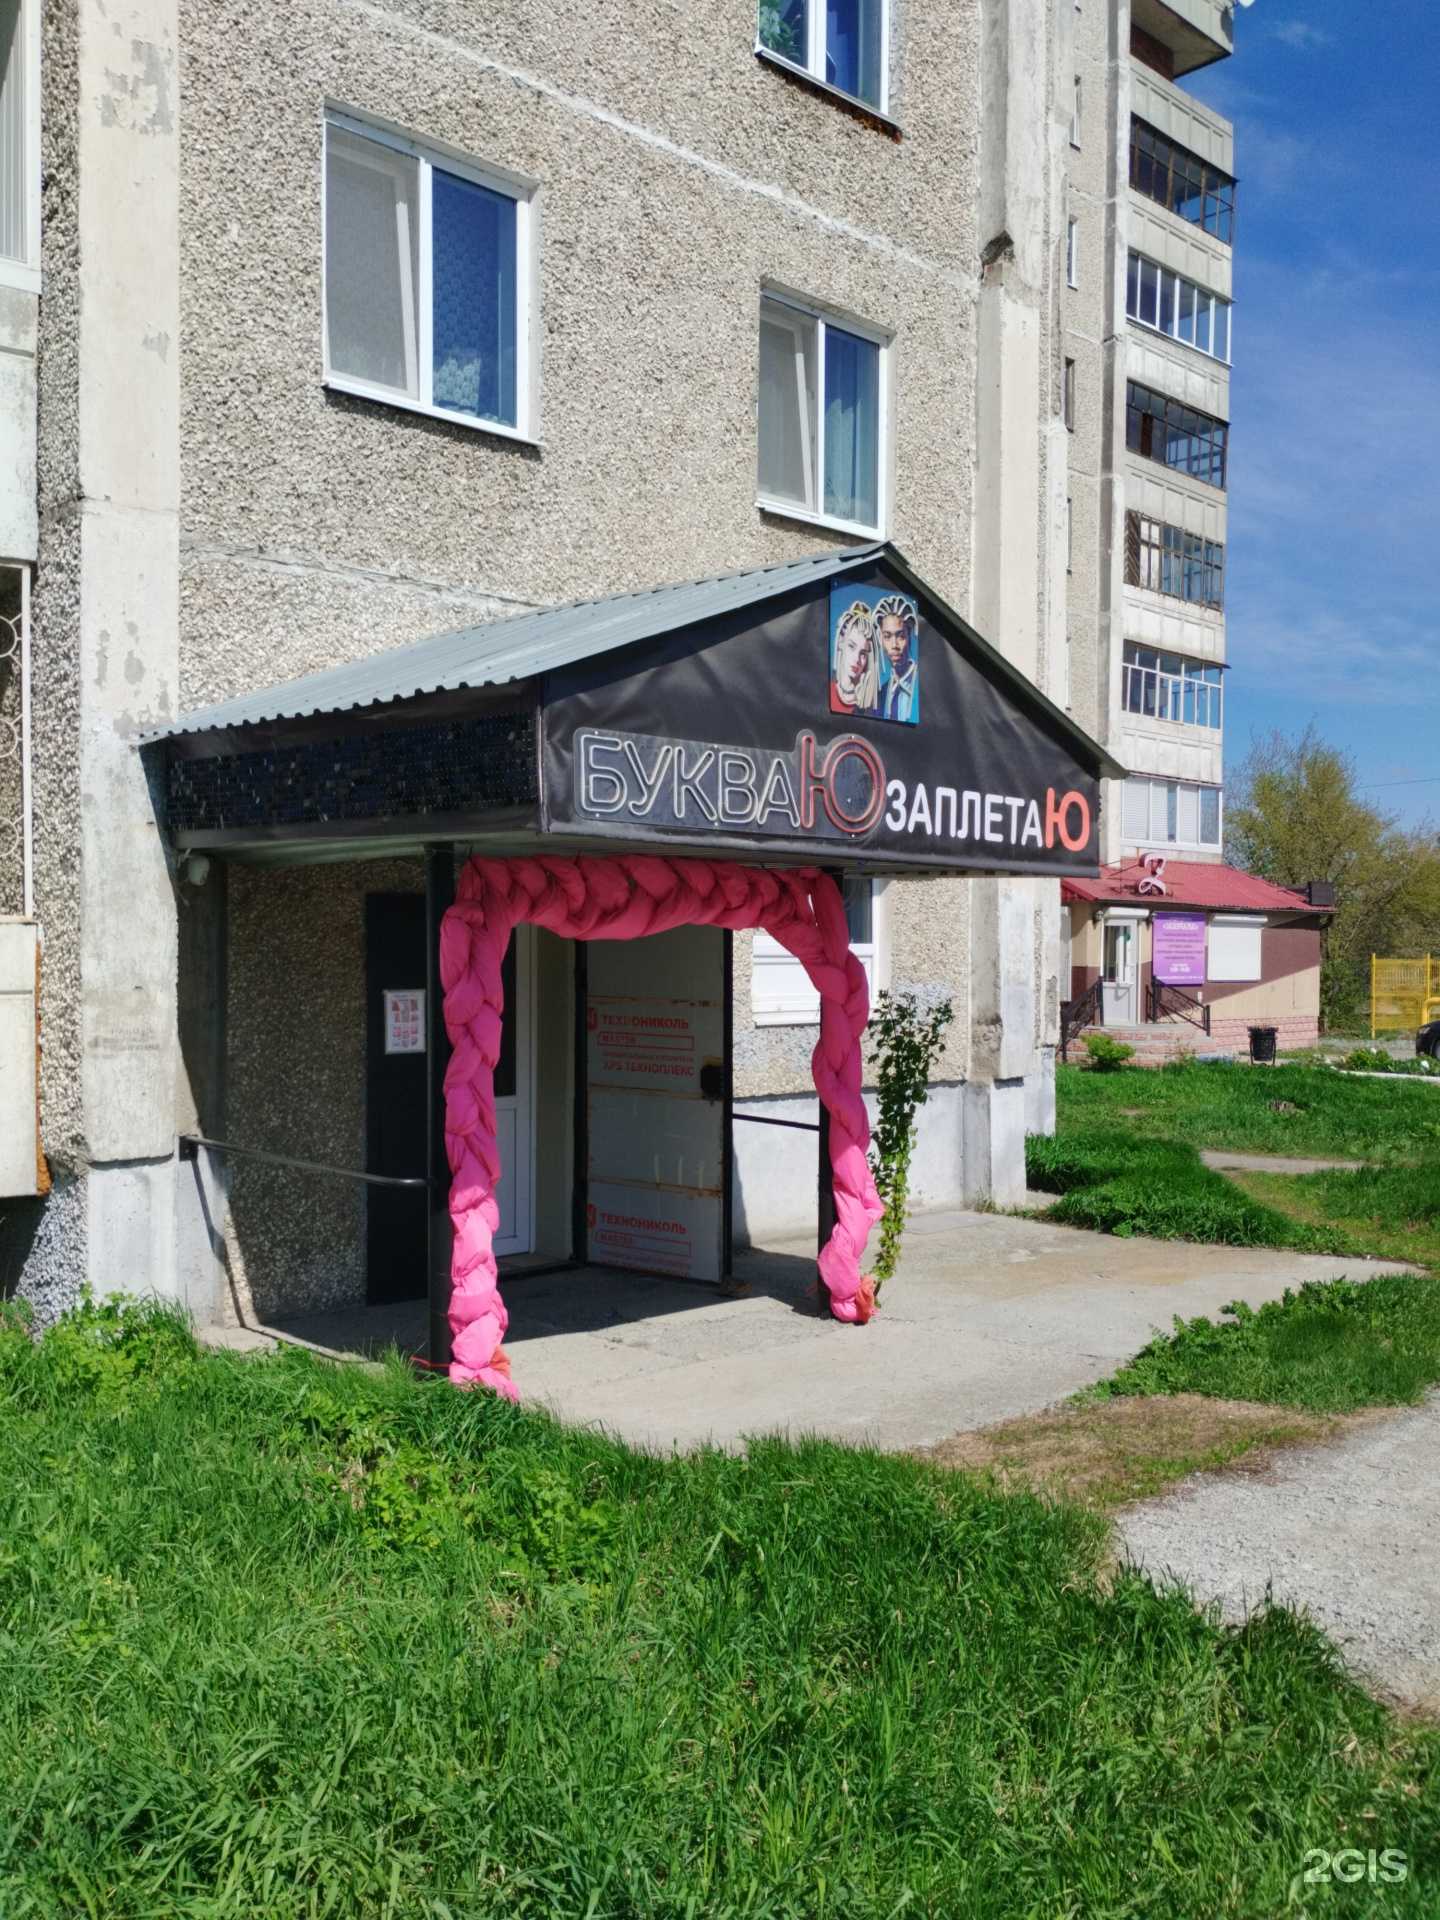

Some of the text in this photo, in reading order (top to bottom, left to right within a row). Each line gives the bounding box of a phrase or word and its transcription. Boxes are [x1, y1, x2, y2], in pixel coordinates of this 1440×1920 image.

[886, 779, 1090, 852] ЗАПЛЕТАЮ
[601, 1015, 688, 1029] ТЕХНОНИКОЛЬ
[601, 1213, 686, 1233] ТЕХНОНИКОЛЬ
